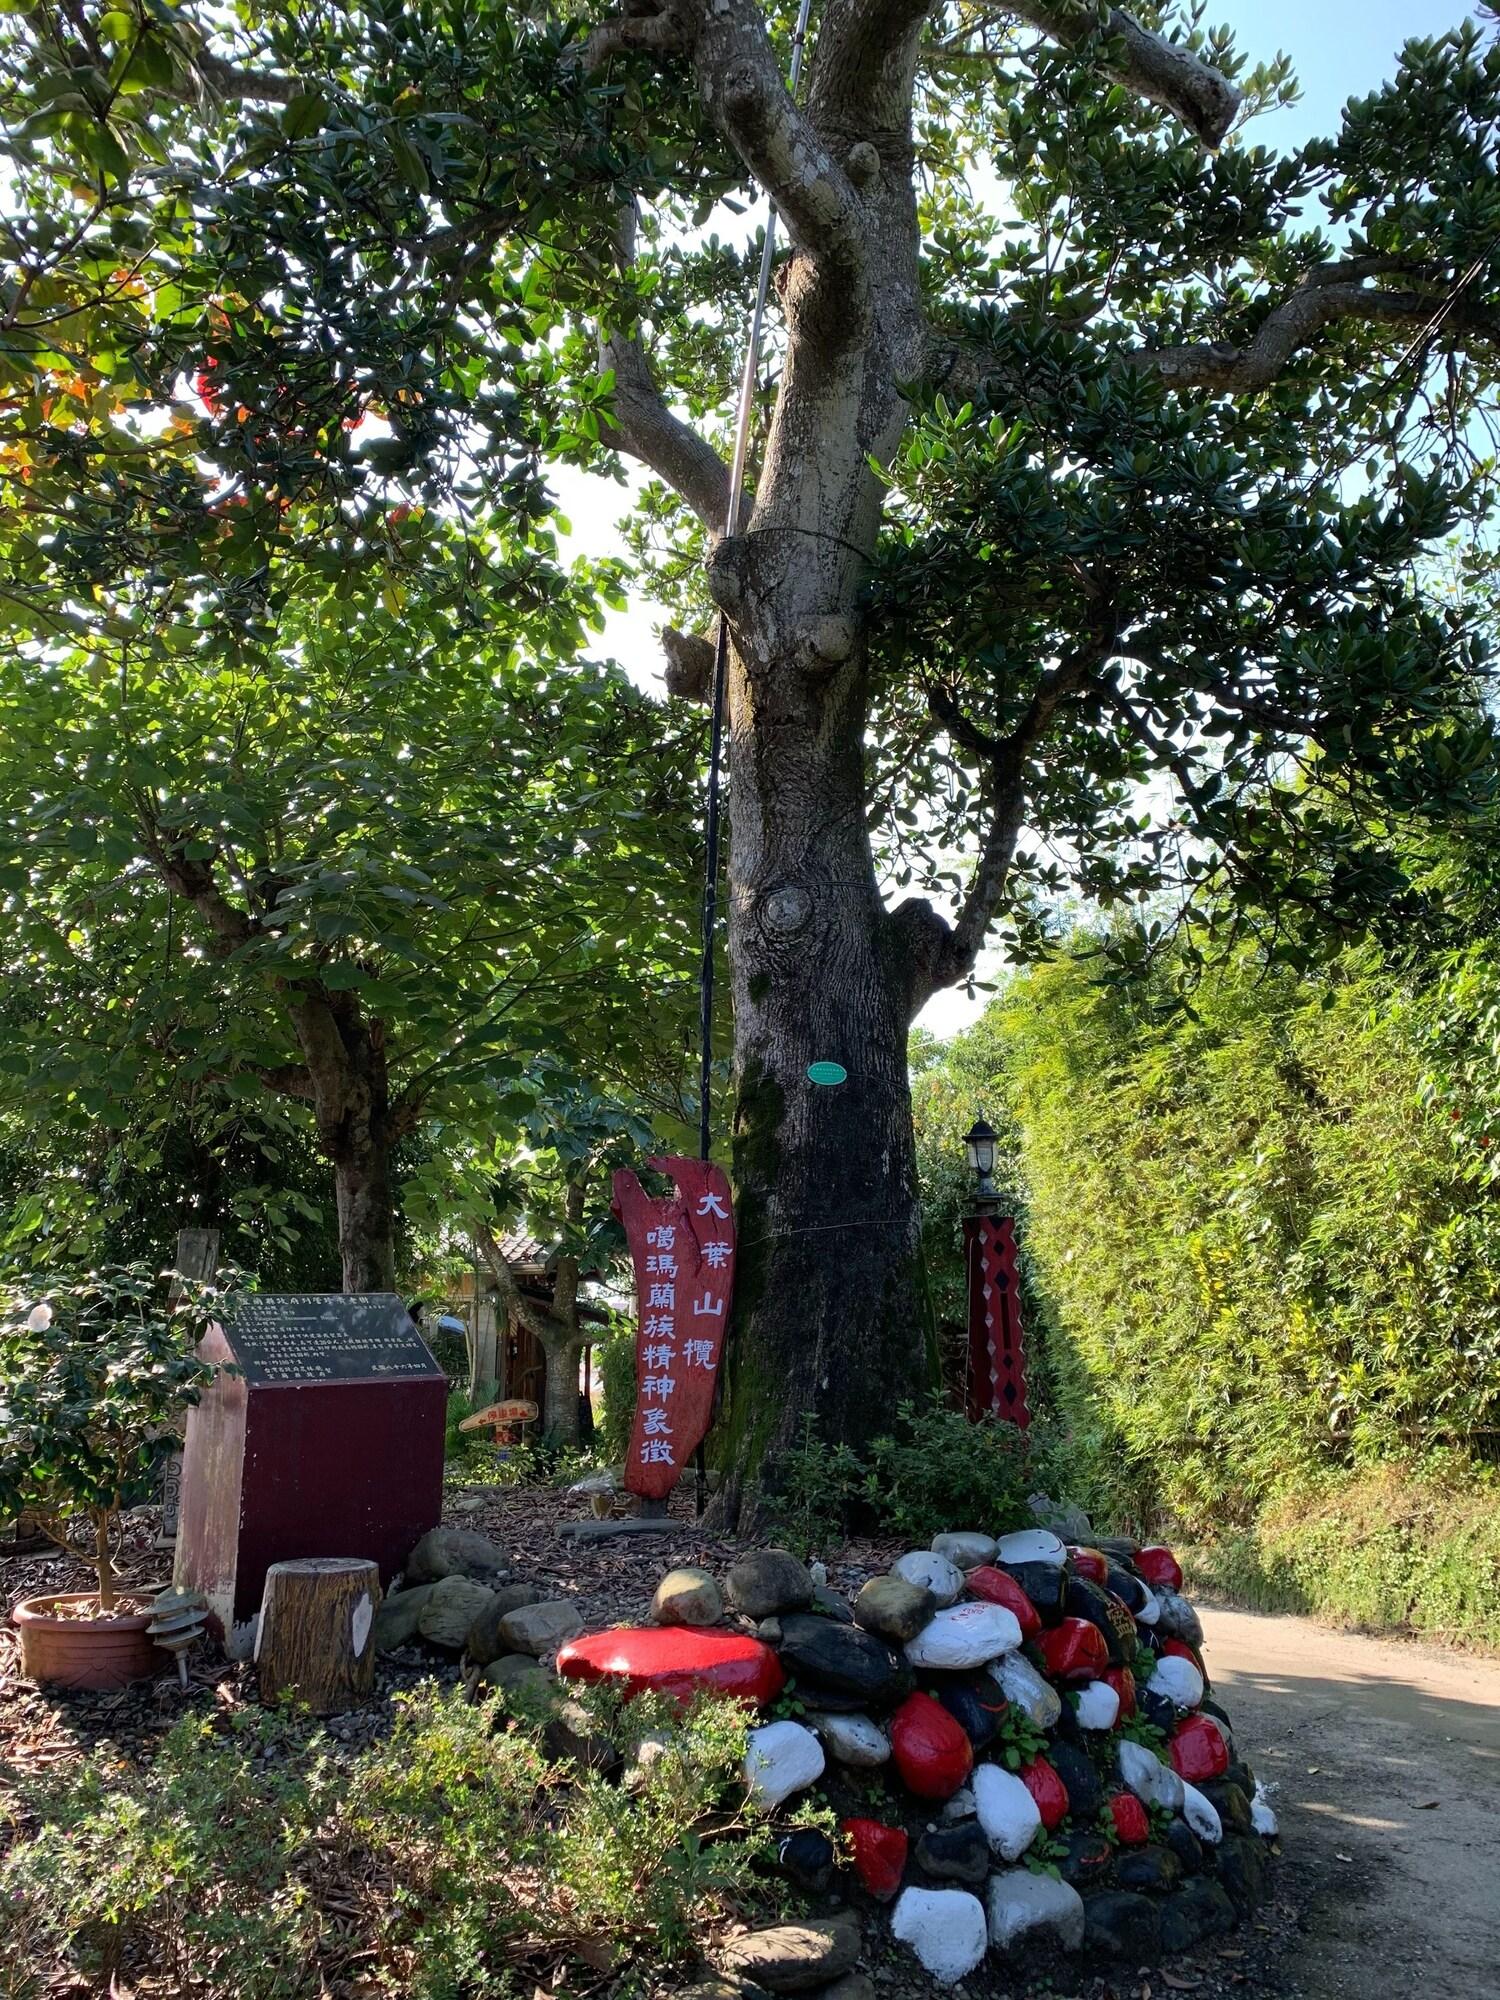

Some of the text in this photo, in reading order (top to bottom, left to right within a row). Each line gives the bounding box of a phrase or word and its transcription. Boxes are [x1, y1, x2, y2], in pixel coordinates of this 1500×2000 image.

[640, 1225, 679, 1466] 噶瑪蘭族精神象徵
[682, 1192, 733, 1370] 大葉山欖
